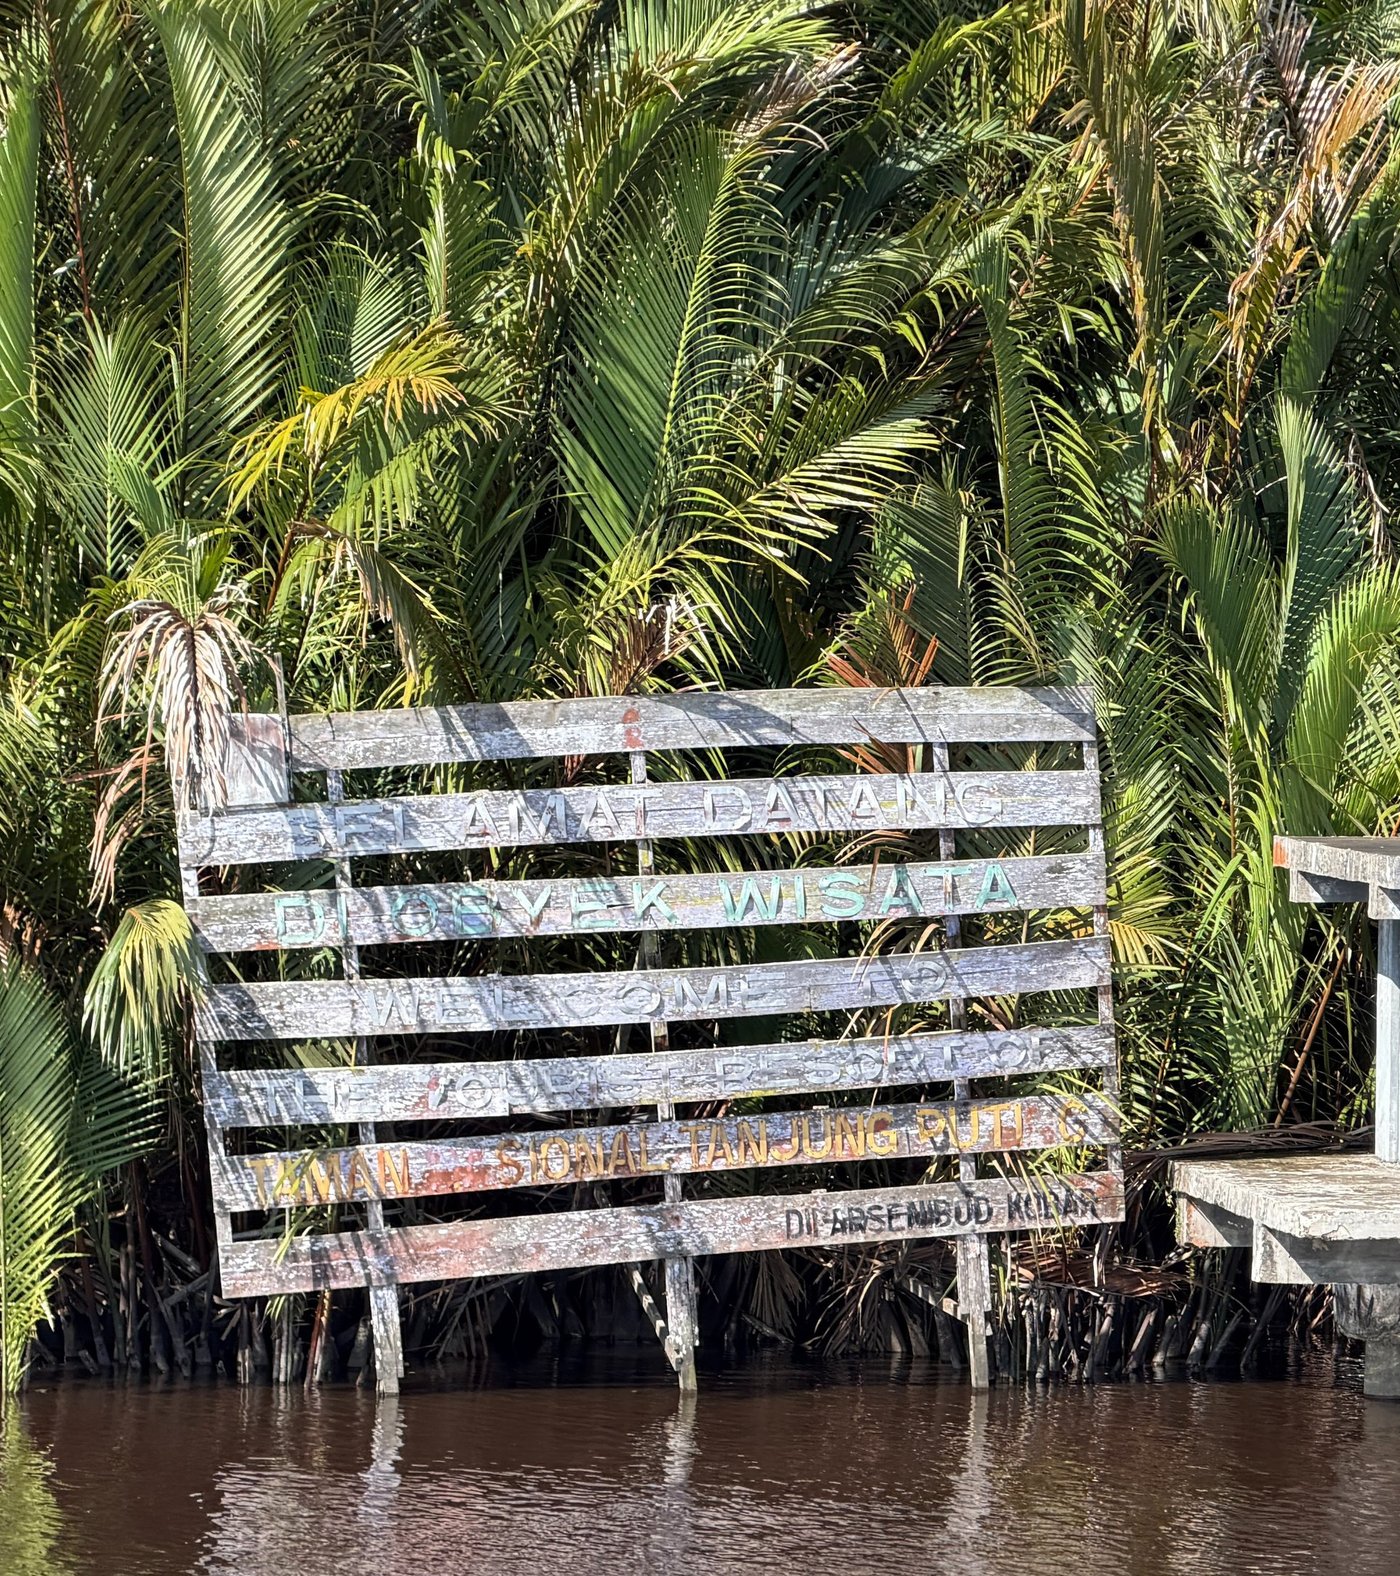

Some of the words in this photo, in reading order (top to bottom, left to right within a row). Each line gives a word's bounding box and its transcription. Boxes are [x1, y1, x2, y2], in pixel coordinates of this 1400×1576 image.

[285, 785, 663, 856] SELAMAT
[702, 778, 1003, 832] DATANG
[718, 863, 1021, 923] WISATA
[362, 971, 787, 1027] WELCOME
[842, 959, 947, 999] TO
[252, 1076, 380, 1118] THE
[714, 1040, 966, 1092] RESORT
[243, 1148, 411, 1209] TAMAN
[494, 1128, 670, 1186] SIONAL
[681, 1109, 898, 1169] TANJUNG
